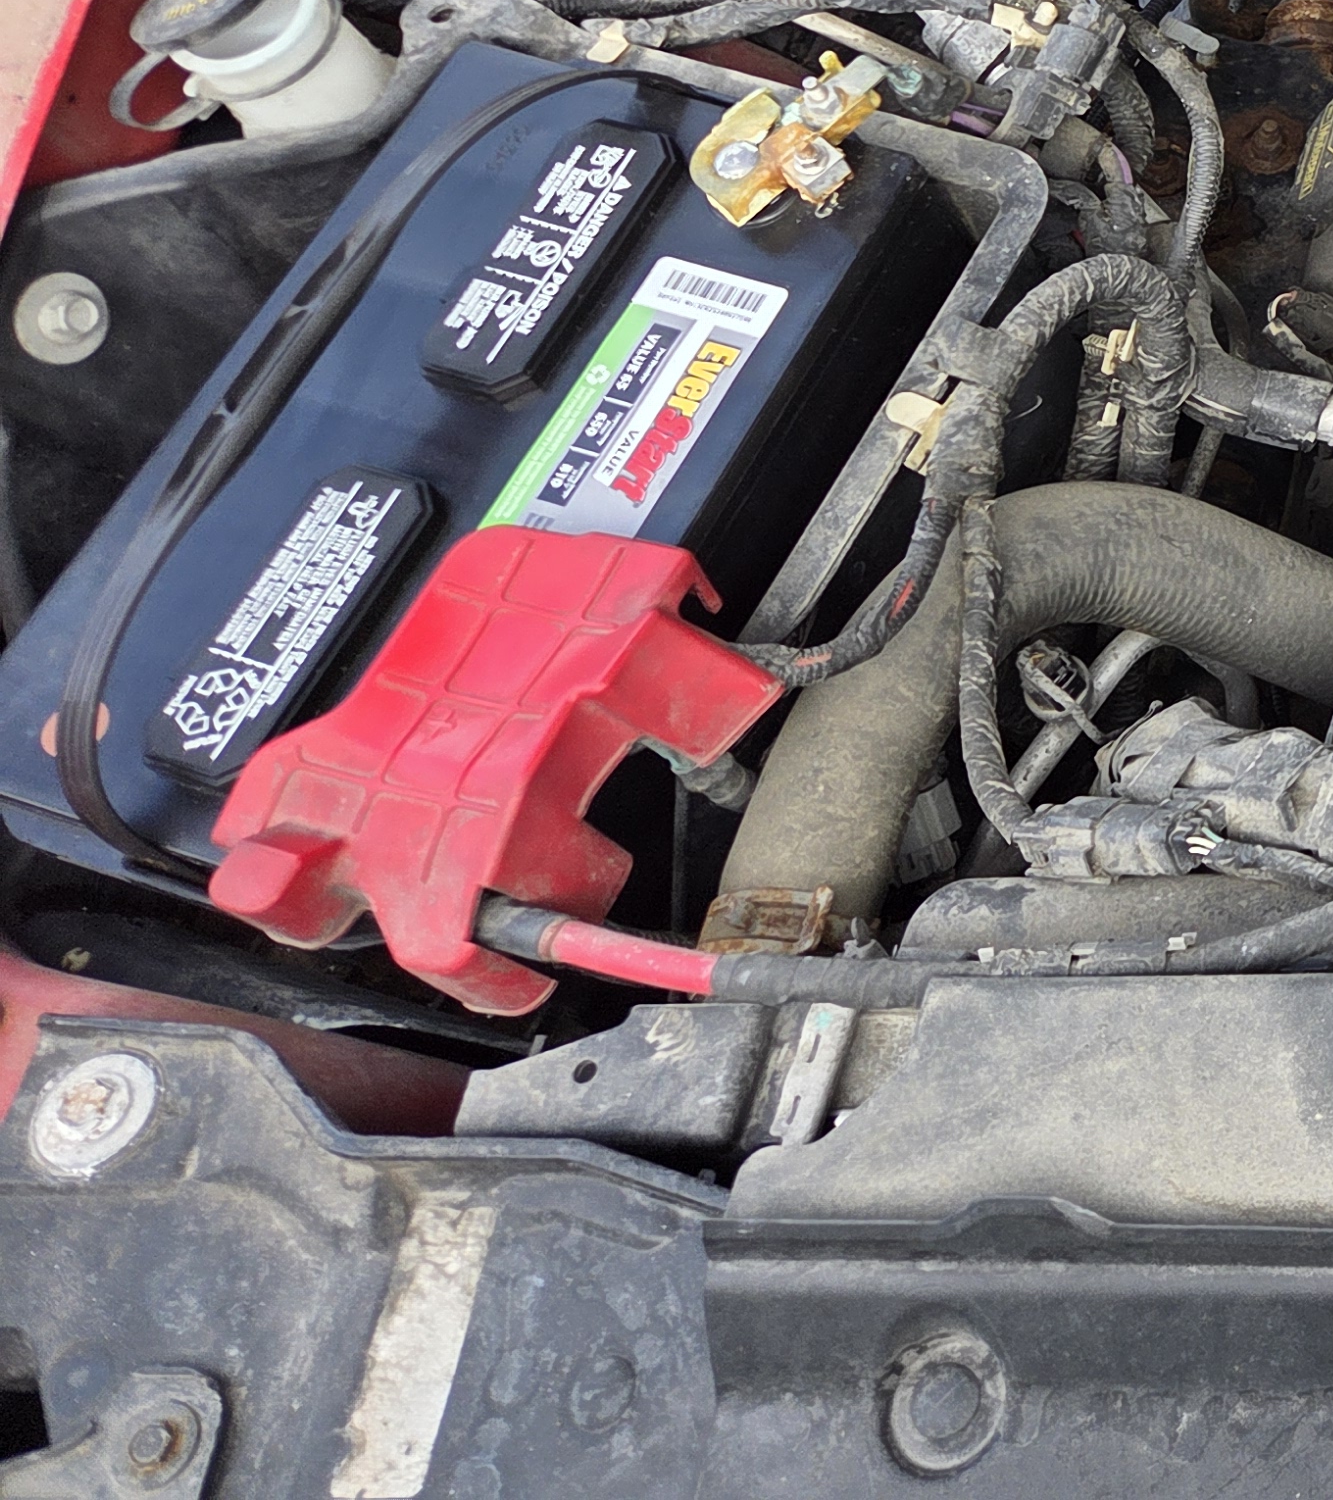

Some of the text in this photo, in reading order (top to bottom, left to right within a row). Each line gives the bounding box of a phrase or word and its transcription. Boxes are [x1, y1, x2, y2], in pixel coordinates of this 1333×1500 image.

[565, 191, 623, 256] DANGER
[513, 271, 566, 334] POISON
[613, 333, 661, 393] VALUE 65
[600, 429, 639, 477] VALUE
[610, 338, 743, 505] EverStart
